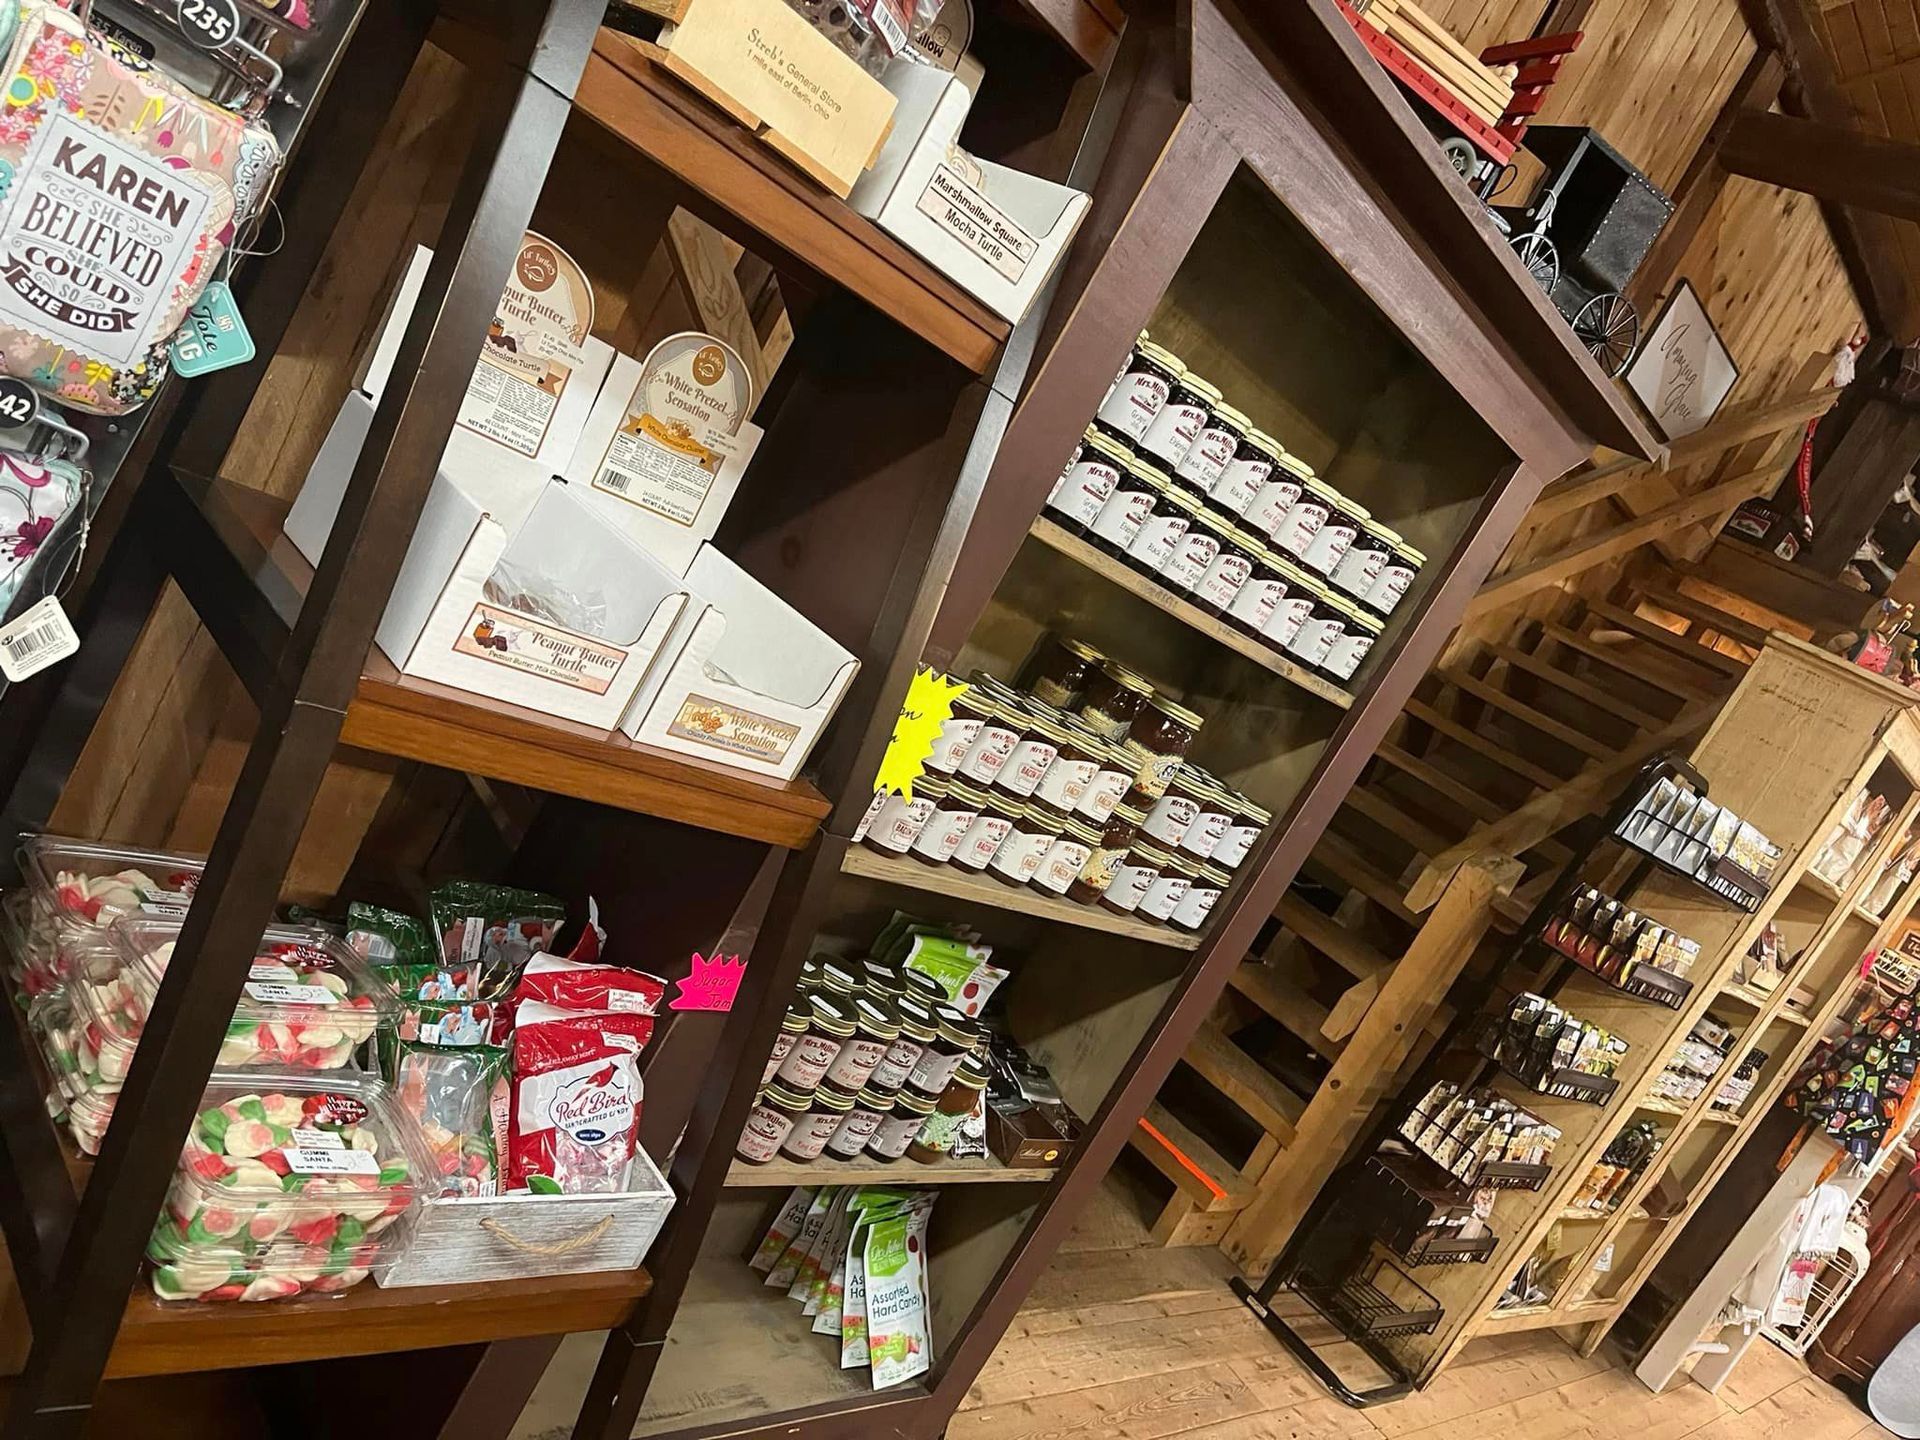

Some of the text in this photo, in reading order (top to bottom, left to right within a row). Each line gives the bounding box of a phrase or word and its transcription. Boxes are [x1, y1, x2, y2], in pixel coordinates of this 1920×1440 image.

[182, 0, 233, 41] 235
[114, 26, 143, 54] Karen
[752, 54, 767, 71] mile
[768, 66, 783, 85] east
[783, 79, 793, 90] of
[814, 104, 830, 120] Ohio
[787, 64, 820, 95] General
[820, 90, 842, 113] Store
[52, 136, 190, 228] KAREN
[89, 201, 122, 226] SHE
[934, 174, 1022, 251] Marshmallow Square
[20, 192, 163, 287] BELIEVED
[944, 208, 1003, 261] Mocha Turtle
[26, 246, 130, 305] COULD
[65, 249, 103, 272] SHE
[15, 279, 114, 330] SHE DID
[61, 282, 80, 302] SO
[501, 296, 537, 326] Turtle
[527, 295, 565, 326] Butter
[194, 305, 217, 353] Tote
[175, 330, 202, 361] AG
[518, 357, 541, 373] Turtle
[0, 394, 31, 421] 42
[664, 371, 728, 413] White Pretzel
[665, 391, 711, 422] Sensation
[532, 631, 618, 670] Peanut Butter
[551, 653, 587, 675] Turtle
[550, 668, 580, 683] Chocolate
[729, 712, 797, 742] White Pretzel
[731, 727, 778, 751] Sensation
[693, 970, 733, 989] Sugar
[700, 994, 731, 1009] Jam
[555, 1088, 629, 1123] Red Bird
[872, 1285, 910, 1306] Assorted
[872, 1294, 920, 1320] Hard Candy
